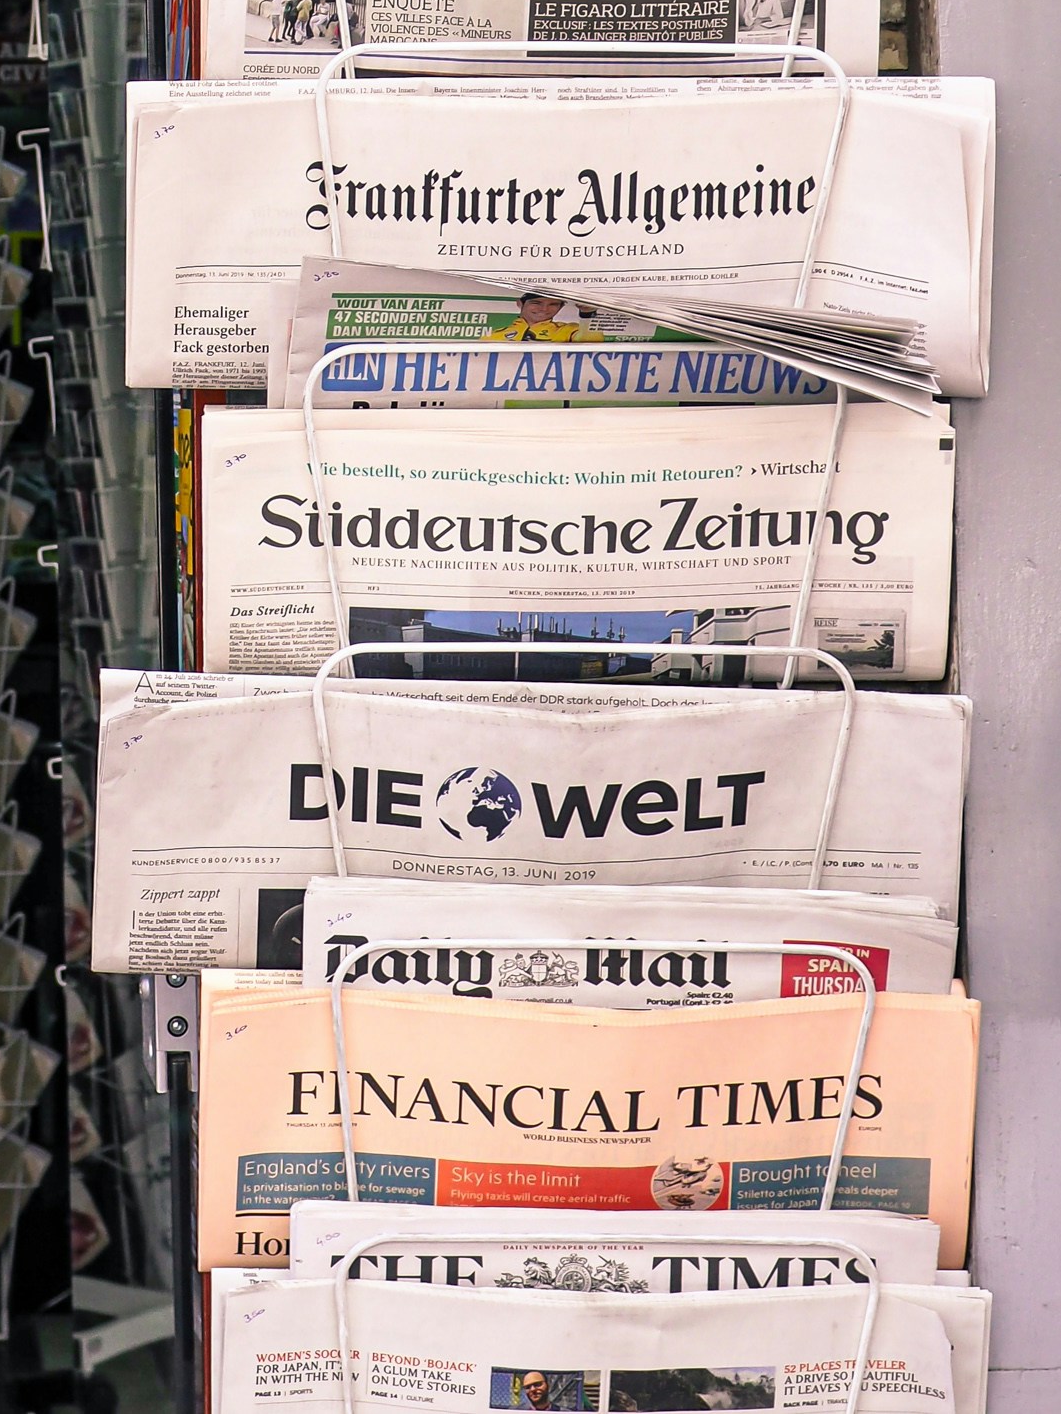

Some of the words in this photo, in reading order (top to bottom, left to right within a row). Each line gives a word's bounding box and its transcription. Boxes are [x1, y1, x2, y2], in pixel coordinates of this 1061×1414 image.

[534, 2, 556, 17] LE
[562, 2, 627, 18] FIGARO
[394, 13, 431, 24] VILLES
[435, 16, 463, 26] FACE
[617, 20, 658, 30] TEXTES
[661, 19, 727, 29] POSTHUMES
[371, 24, 425, 35] VIOLENCE
[461, 28, 511, 39] MINEURS
[244, 64, 274, 75] CORÉE
[292, 66, 320, 75] NORD
[306, 160, 565, 236] Frankfurter
[568, 164, 815, 237] Allgemeine
[438, 244, 512, 257] ZEITUNG
[520, 243, 552, 258] FÜR
[560, 243, 684, 257] DEUTSCHLAND
[337, 300, 376, 310] WOUT
[380, 300, 408, 310] VAN
[412, 300, 445, 310] AERT
[175, 306, 249, 321] Ehemaliger
[353, 312, 427, 324] SECONDEN
[430, 314, 488, 324] SNELLER
[174, 324, 257, 339] Herausgeber
[173, 341, 204, 354] Fack
[206, 341, 269, 356] gestorben
[481, 350, 662, 392] LAATSTE
[342, 463, 405, 480] bestellt,
[574, 470, 625, 485] Wohin
[662, 465, 743, 482] Retouren?
[258, 493, 653, 556] Süddeutsche
[660, 497, 889, 565] Zeitung
[587, 561, 638, 573] KULTUR,
[643, 558, 718, 570] WIRTSCHAFT
[753, 555, 791, 565] SPORT
[230, 606, 253, 617] Das
[256, 604, 315, 618] Streiflicht
[289, 763, 424, 829] DIE
[132, 859, 199, 867] KUNDENSERVICE
[392, 859, 498, 878] DONNERSTAG,
[524, 868, 557, 880] JUNI
[565, 870, 596, 880] 2019
[141, 887, 184, 902] Zippert
[188, 887, 220, 903] zappt
[324, 935, 494, 998] Daily
[583, 937, 731, 988] Mail
[287, 1070, 661, 1134] FINANCIAL
[677, 1074, 883, 1128] TIMES
[245, 1160, 330, 1178] England's
[380, 1163, 430, 1179] rivers
[451, 1166, 484, 1186] Sky
[507, 1169, 537, 1186] the
[541, 1170, 581, 1188] limit
[739, 1163, 811, 1184] Brought
[385, 1185, 425, 1197] sewage
[282, 1361, 322, 1373] JAPAN,
[372, 1353, 420, 1367] BEYOND
[799, 1361, 841, 1372] PLACES
[271, 1374, 302, 1384] WITH
[383, 1365, 418, 1378] GLUM
[421, 1370, 452, 1381] TAKE
[796, 1373, 830, 1384] DRIVE
[393, 1378, 424, 1390] LOVE
[427, 1382, 476, 1395] STORIES
[798, 1383, 841, 1394] LEAVES
[872, 1383, 946, 1400] SPEECHLESS
